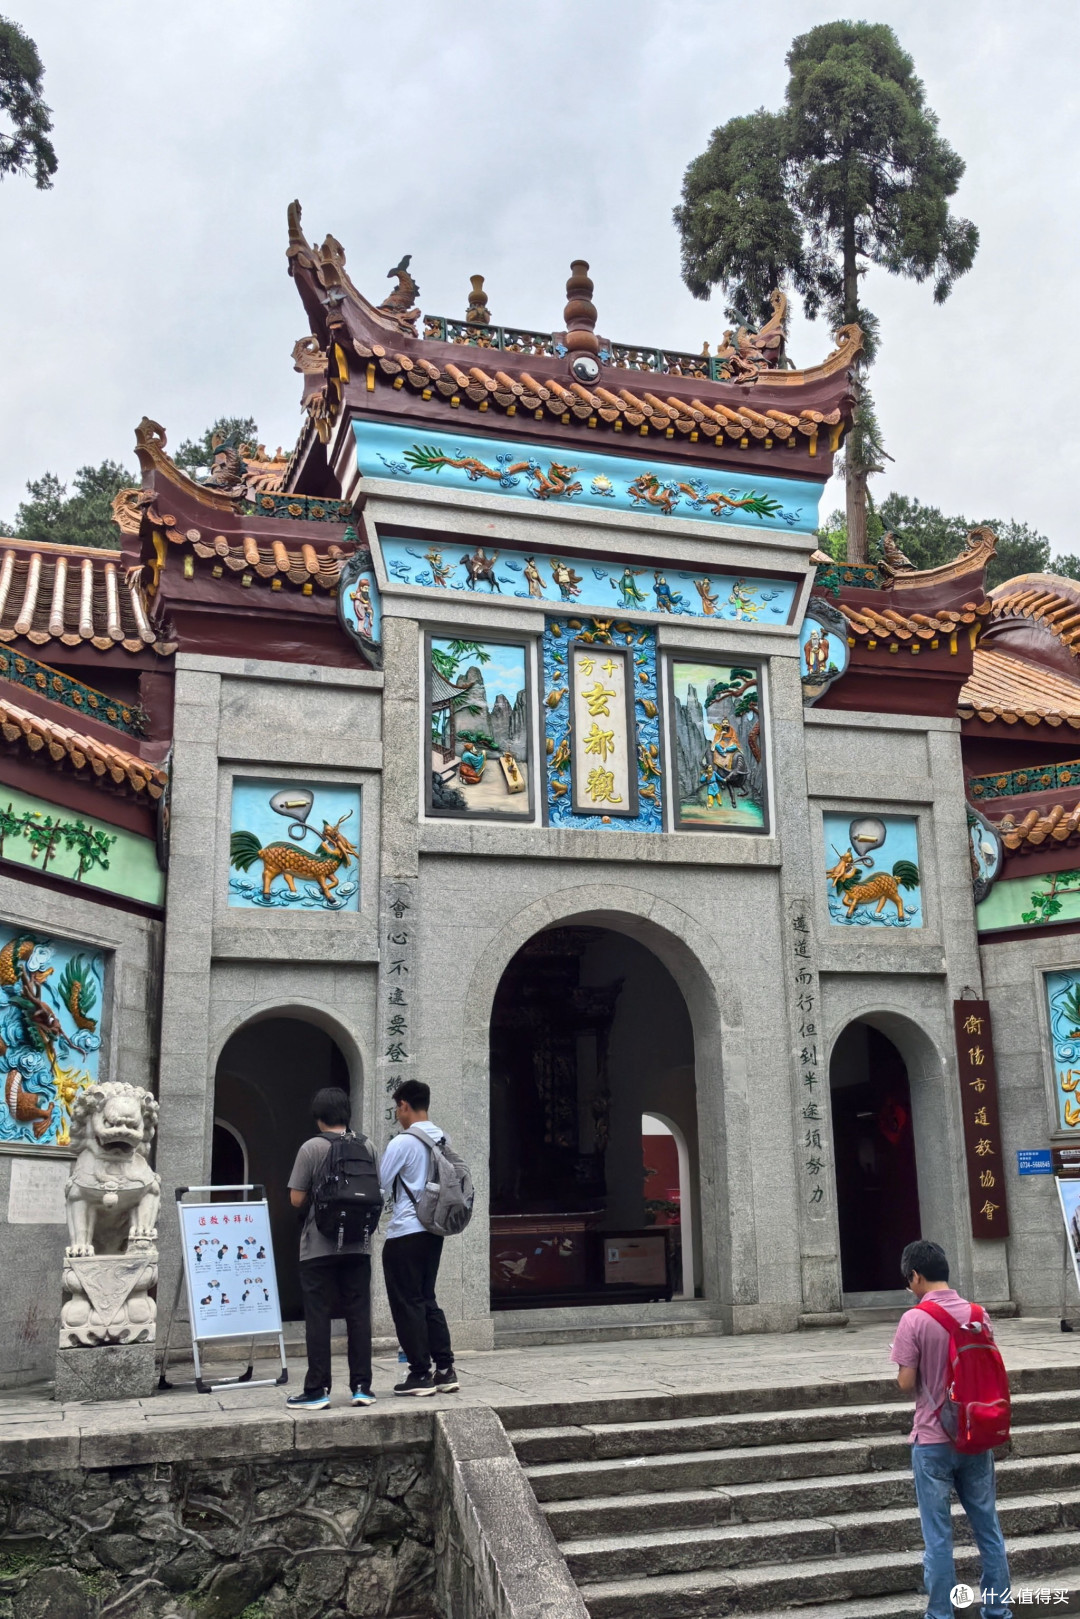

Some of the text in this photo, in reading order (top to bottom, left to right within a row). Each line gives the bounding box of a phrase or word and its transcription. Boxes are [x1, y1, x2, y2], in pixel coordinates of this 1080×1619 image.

[580, 681, 623, 804] 玄都觀
[963, 1014, 1000, 1220] 衡陽市道教協會
